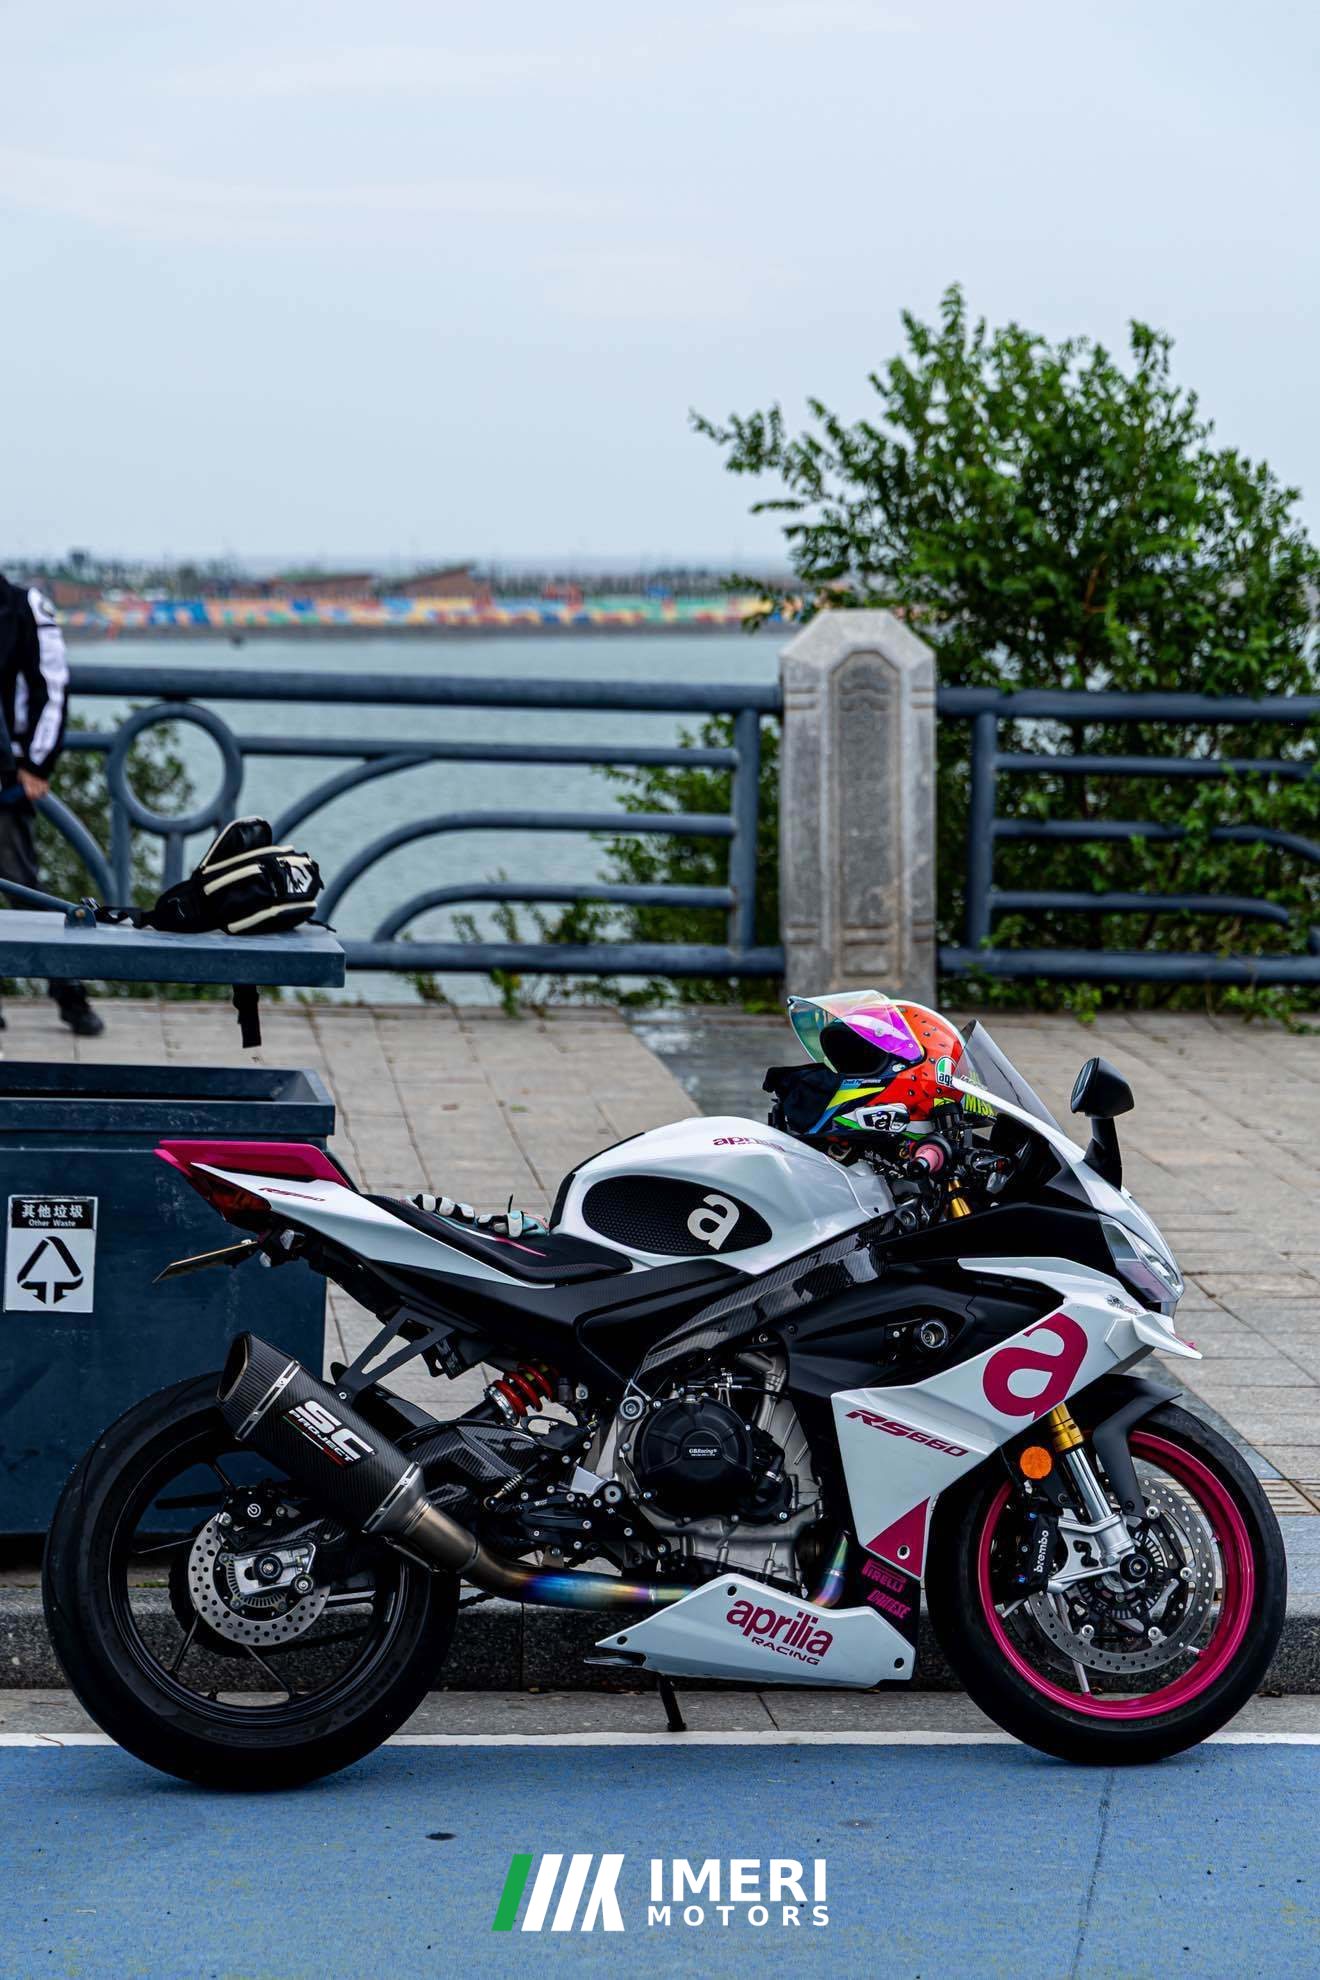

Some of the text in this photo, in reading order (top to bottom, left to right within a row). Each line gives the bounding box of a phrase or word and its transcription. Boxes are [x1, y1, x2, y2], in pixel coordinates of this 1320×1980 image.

[938, 1072, 953, 1086] ag
[22, 1204, 83, 1218] 其他垃圾
[28, 1218, 76, 1227] Other Waste
[687, 1193, 740, 1250] a
[982, 1311, 1088, 1422] a
[288, 1409, 355, 1462] PROJECT
[295, 1400, 374, 1460] SC
[845, 1409, 970, 1457] RS660
[1033, 1530, 1049, 1573] brembo
[861, 1558, 907, 1593] PIRELLI
[726, 1599, 834, 1657] aprilia
[751, 1636, 820, 1666] RACING
